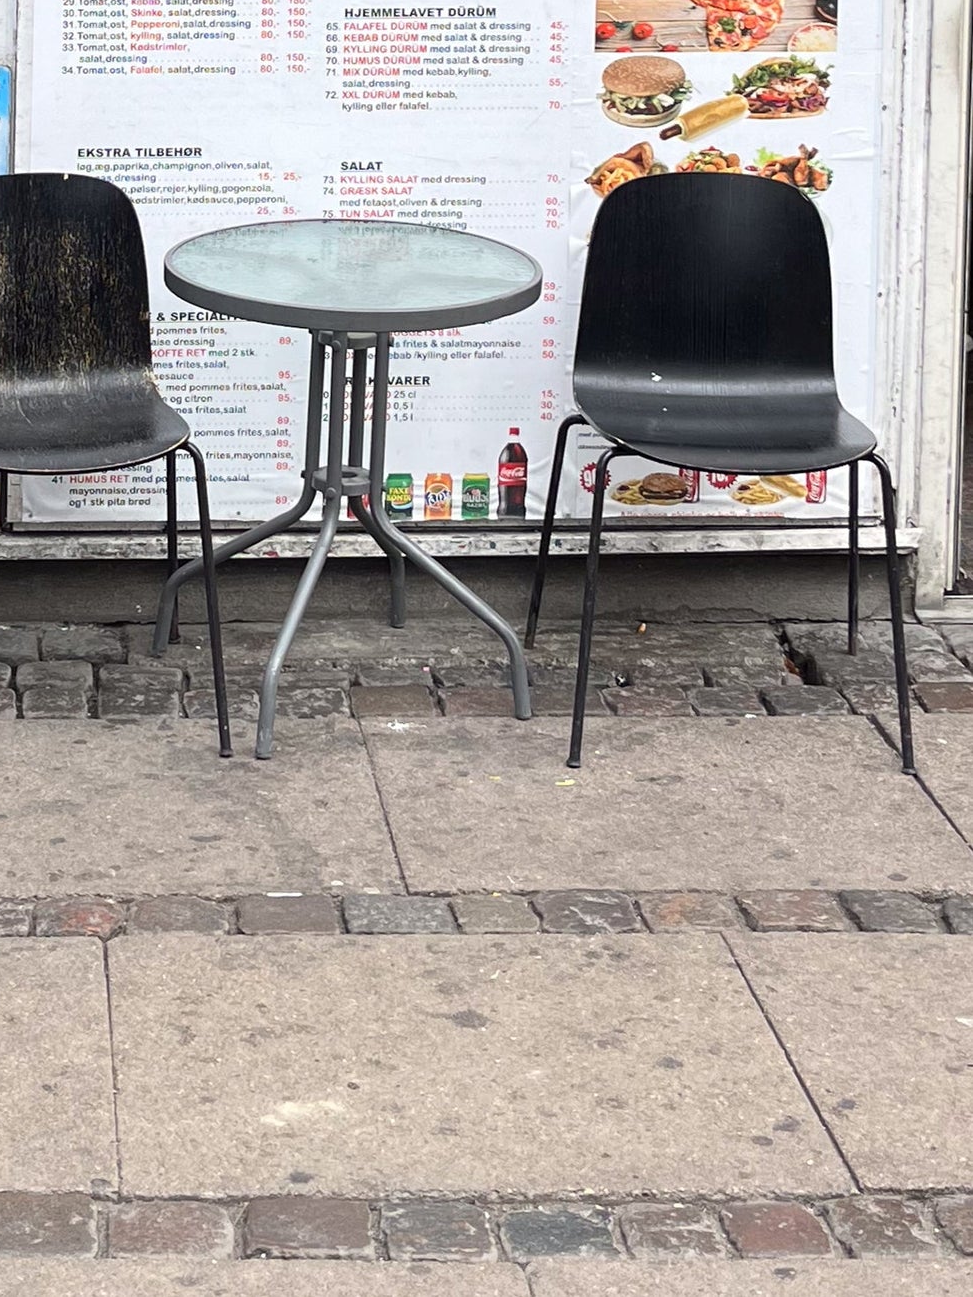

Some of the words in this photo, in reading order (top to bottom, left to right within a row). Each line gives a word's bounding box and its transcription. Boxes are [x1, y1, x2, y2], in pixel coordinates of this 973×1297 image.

[344, 7, 444, 18] HJEMMELAVET
[343, 22, 388, 31] FALAFEL
[430, 21, 452, 31] med
[453, 21, 477, 31] salat
[479, 21, 487, 30] &
[488, 22, 532, 32] dressing
[77, 147, 131, 158] EKSTRA
[134, 147, 202, 158] TILBEHØR
[340, 161, 383, 171] SALAT
[340, 175, 385, 184] KYLLING
[386, 174, 419, 184] SALAT
[420, 175, 443, 184] med
[443, 174, 487, 186] dressing
[339, 186, 379, 196] GRÆSK
[380, 186, 414, 196] SALAT
[156, 312, 166, 322] &
[69, 474, 108, 484] HUMUS
[109, 474, 130, 483] RET
